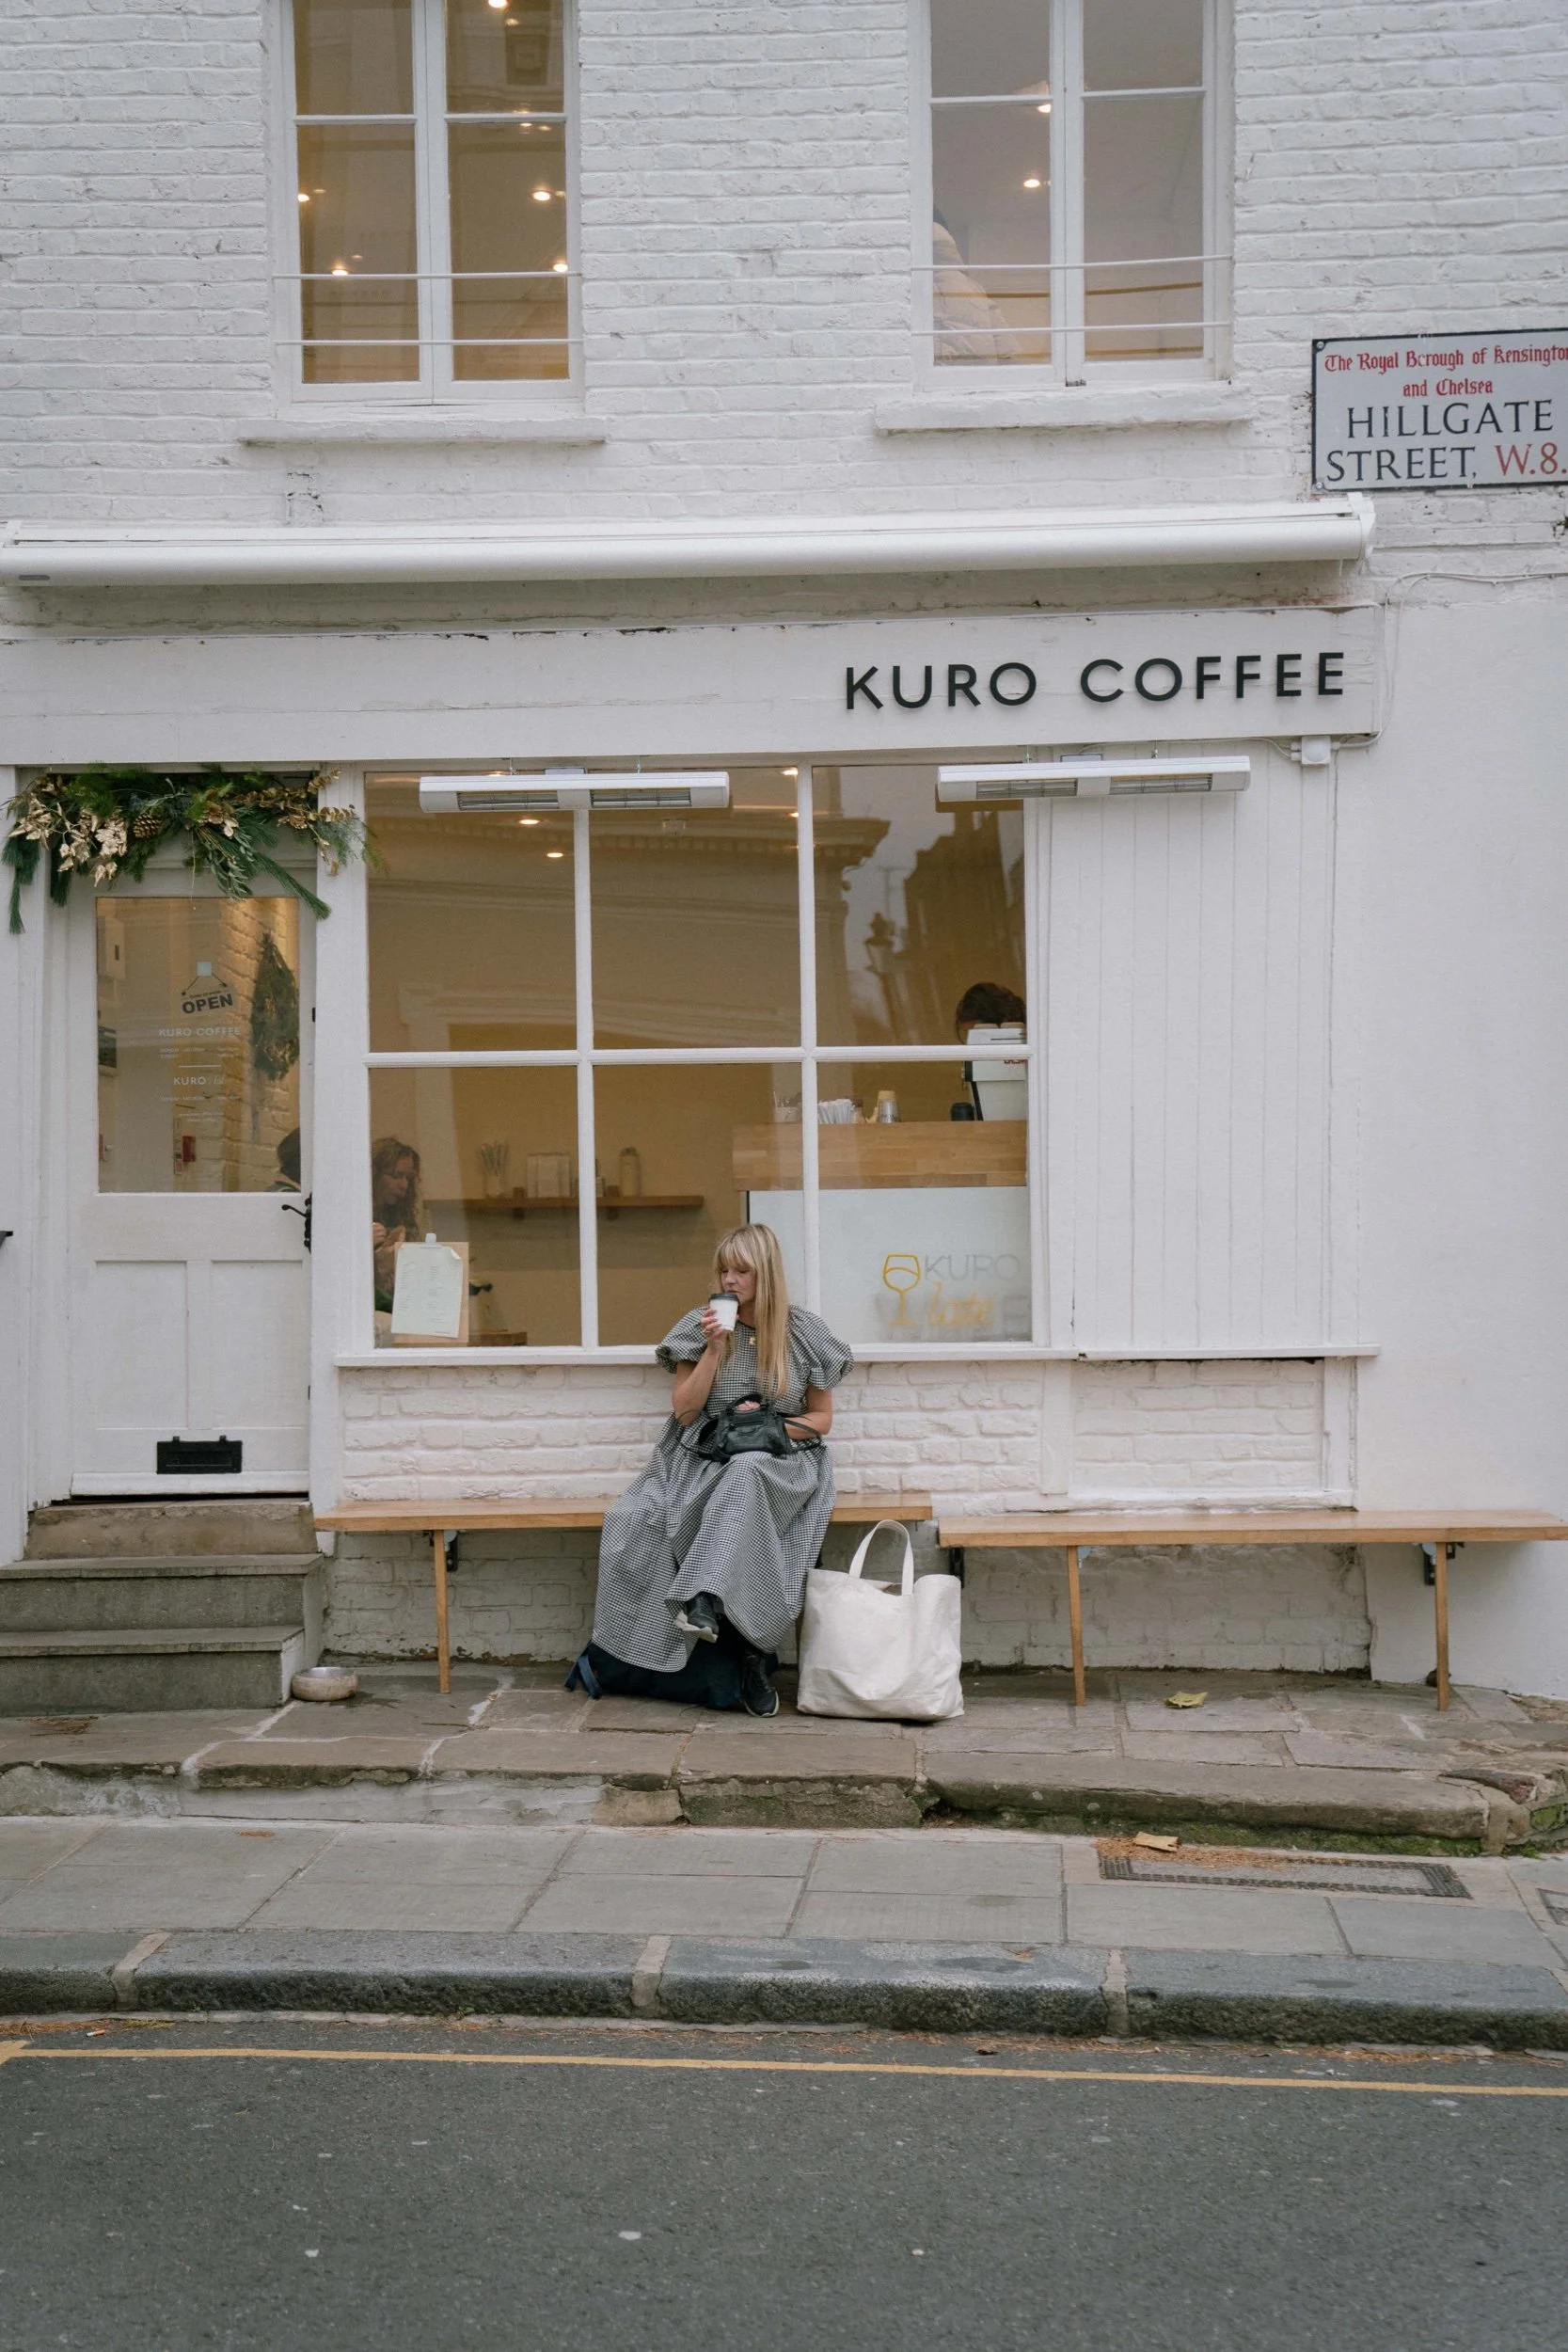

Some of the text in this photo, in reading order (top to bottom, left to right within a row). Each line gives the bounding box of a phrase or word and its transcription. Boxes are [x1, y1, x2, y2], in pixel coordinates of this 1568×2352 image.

[1324, 354, 1353, 373] The
[1357, 352, 1399, 374] Royal
[1406, 349, 1464, 372] Borough
[1472, 347, 1488, 365] of
[1402, 378, 1493, 397] and Chelsea
[1347, 399, 1554, 438] HILLGATE
[1326, 442, 1567, 483] STREET, W.8.
[847, 652, 1345, 710] KURO COFFEE
[182, 993, 233, 1013] OPEN
[159, 1026, 242, 1037] KURO COFFEE
[173, 1076, 207, 1086] KURO
[925, 1253, 1022, 1281] KURO
